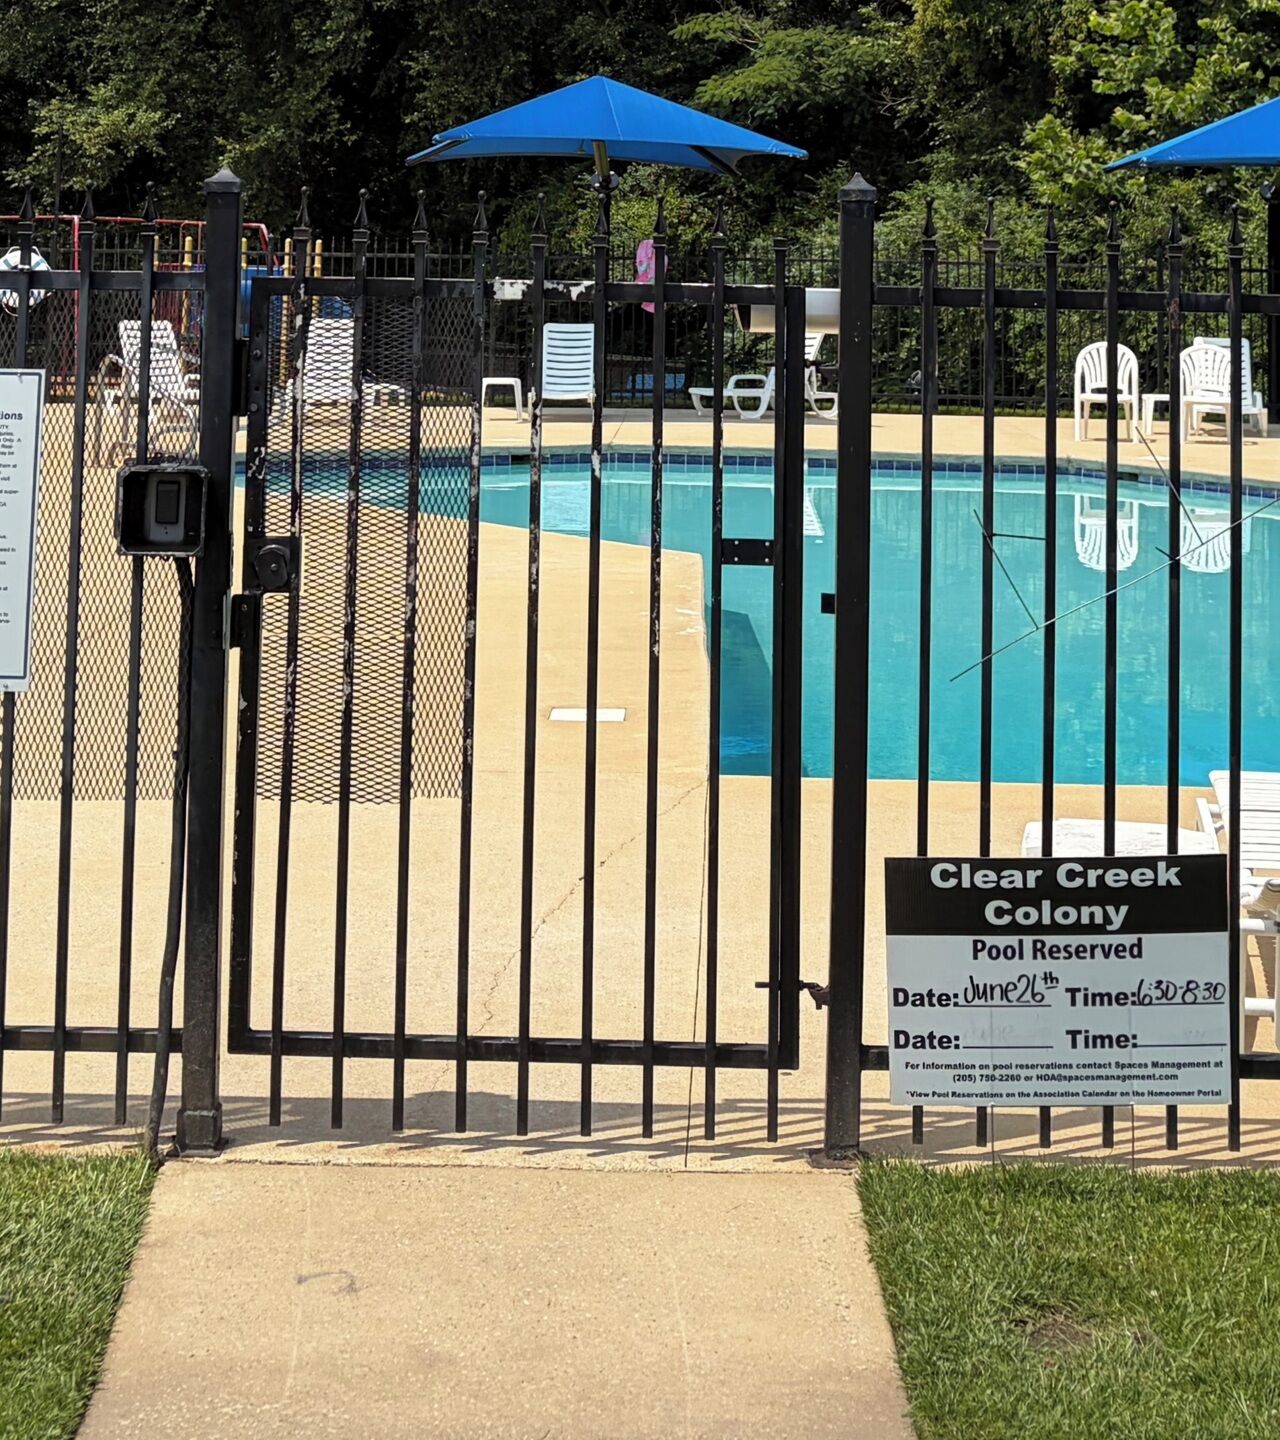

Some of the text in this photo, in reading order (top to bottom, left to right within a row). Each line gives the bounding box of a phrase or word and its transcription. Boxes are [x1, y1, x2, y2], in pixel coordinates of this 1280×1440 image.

[930, 861, 1182, 888] Clear Creek
[984, 900, 1129, 931] Colony
[972, 937, 1142, 960] Pool Reserved
[892, 988, 958, 1007] Date:
[1065, 988, 1136, 1007] Time:
[894, 1030, 1138, 1050] Date: Time:
[905, 1062, 919, 1070] For
[922, 1062, 976, 1070] Information
[992, 1063, 1013, 1072] pool
[1015, 1062, 1073, 1070] reservations
[1114, 1061, 1148, 1070] Spaces
[1151, 1060, 1211, 1070] Management
[953, 1074, 976, 1083] (205)
[980, 1074, 1021, 1082] 750-2260
[1036, 1074, 1178, 1083] HOA@spacesmanagement.com
[1033, 1090, 1080, 1098] Association
[1198, 1089, 1222, 1097] Portal
